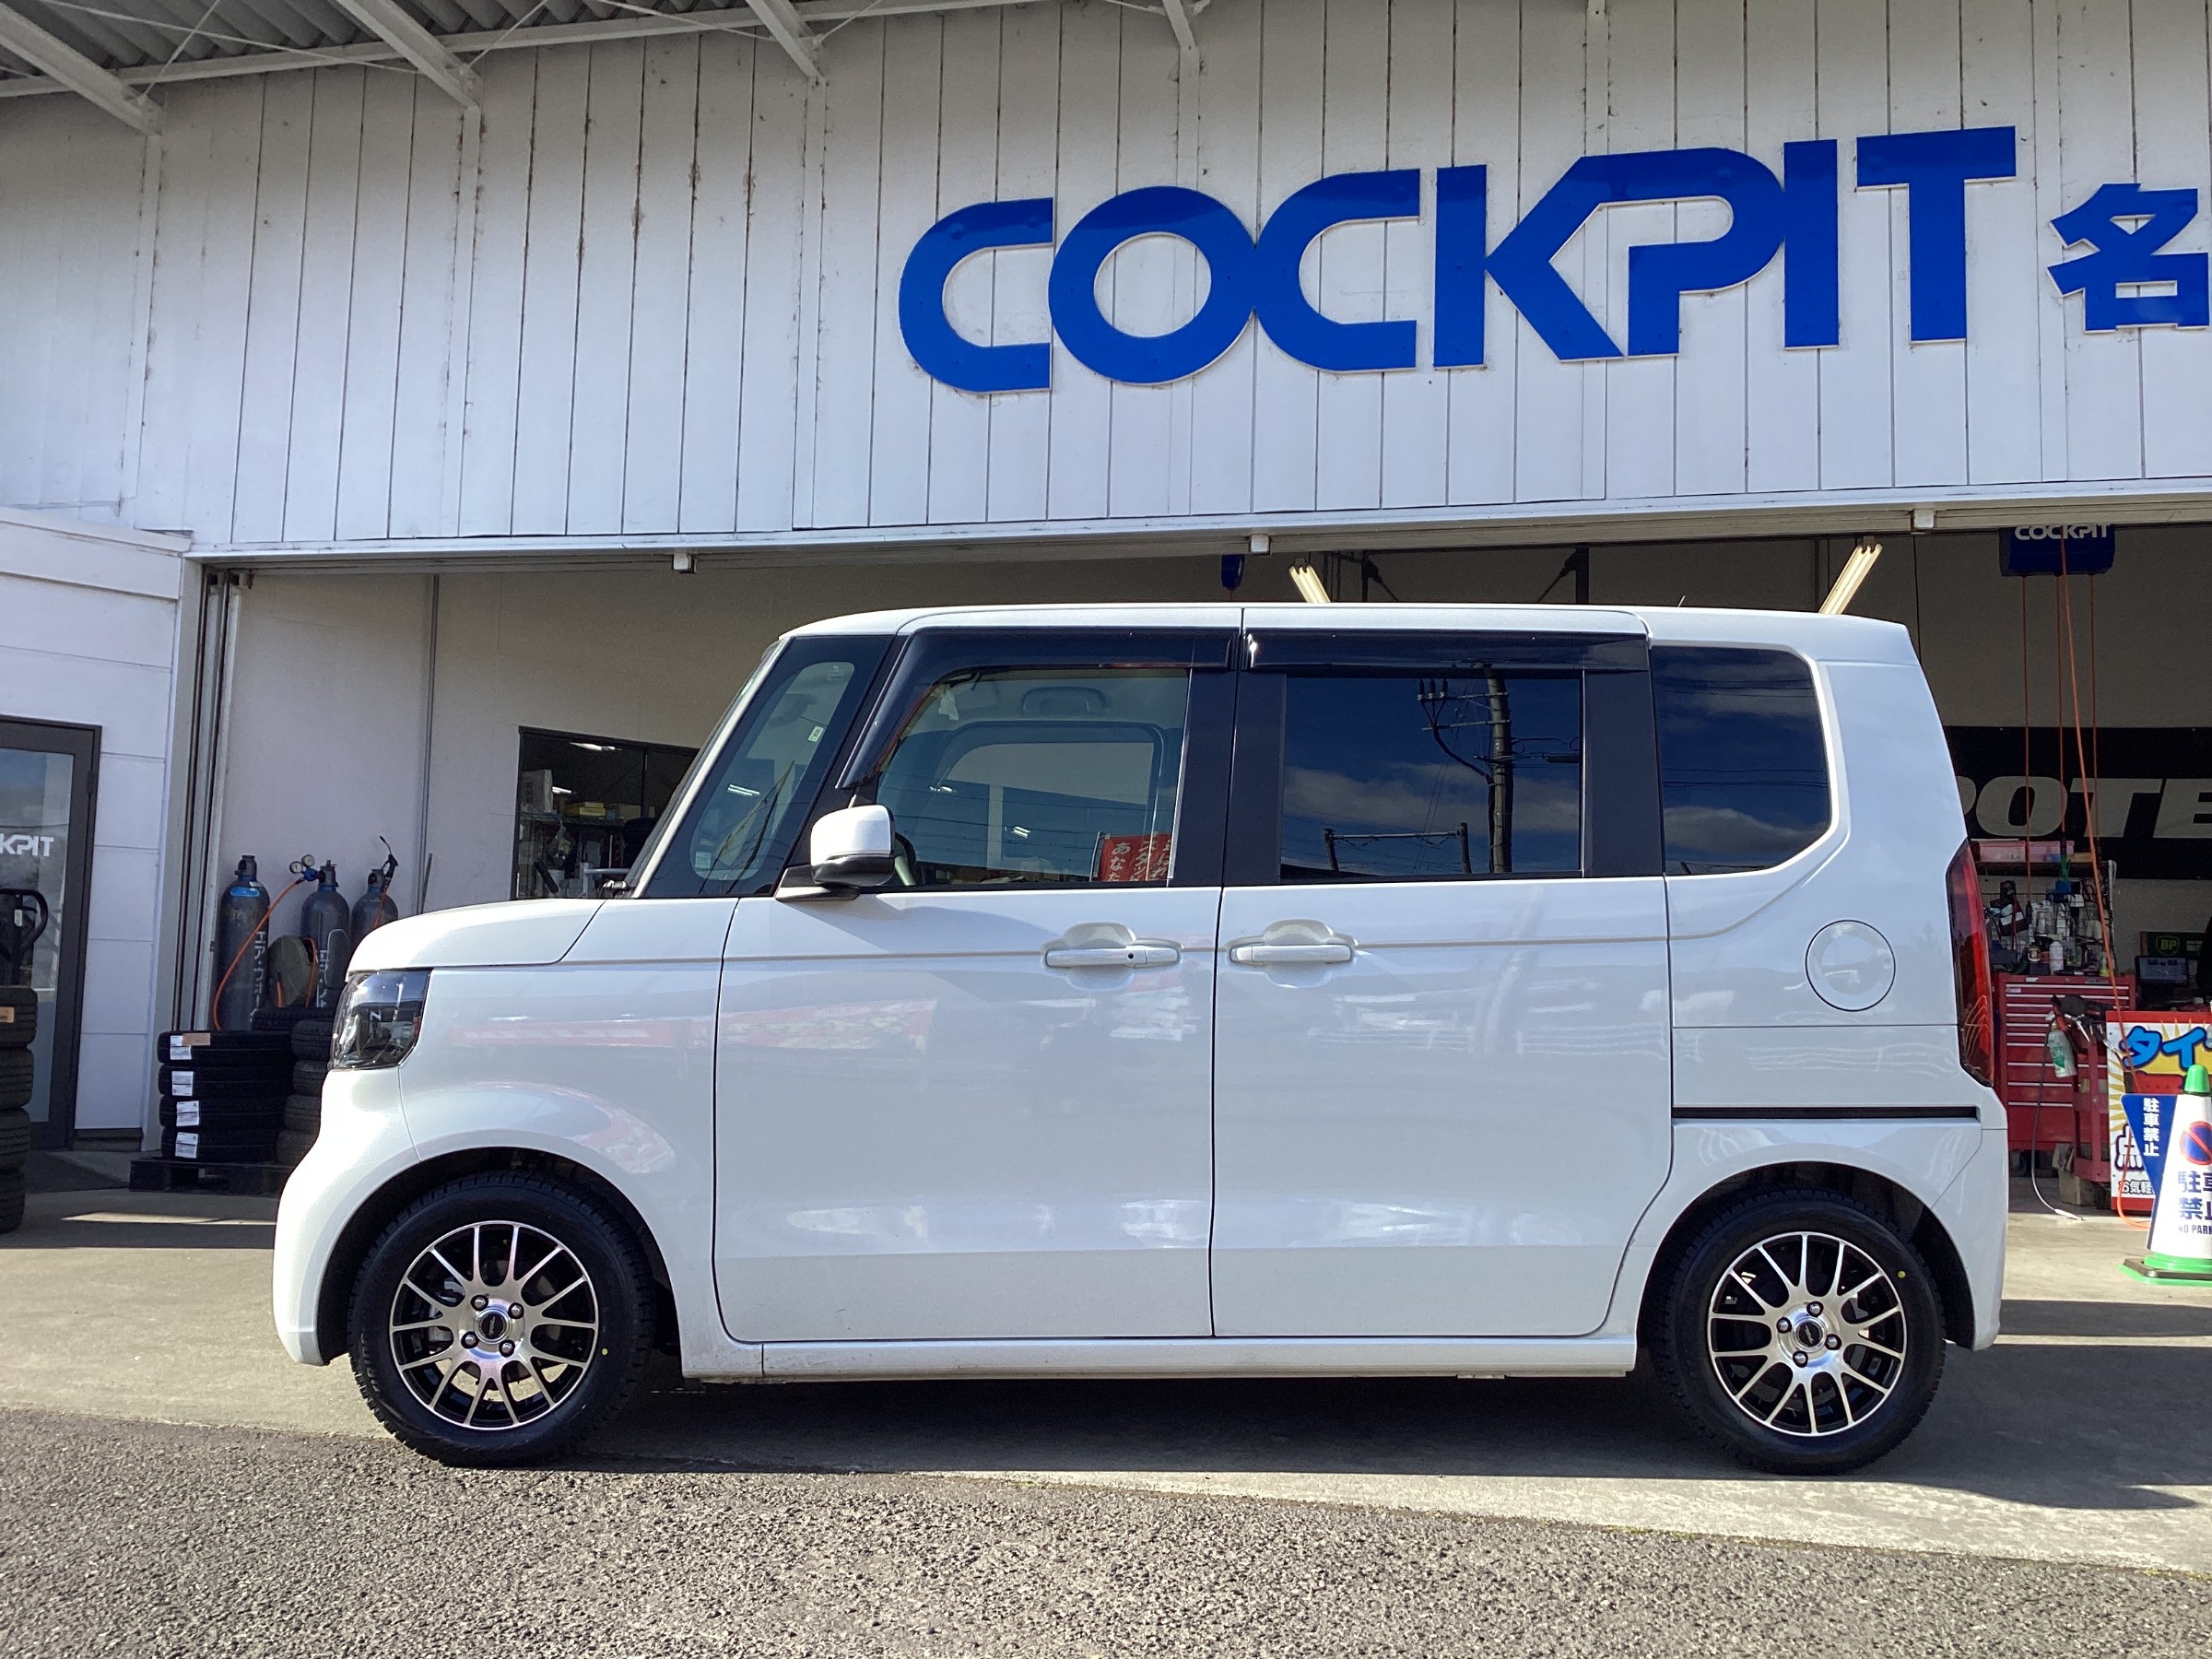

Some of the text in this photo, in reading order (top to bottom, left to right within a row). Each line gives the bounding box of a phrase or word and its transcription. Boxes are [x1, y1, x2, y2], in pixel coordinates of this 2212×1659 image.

[899, 125, 2016, 393] COCKPIT
[2047, 183, 2209, 333] 名
[2014, 524, 2111, 541] COCKPIT
[1956, 775, 2212, 838] OTE
[2160, 939, 2177, 950] BP
[2143, 1097, 2160, 1157] 駐車禁止
